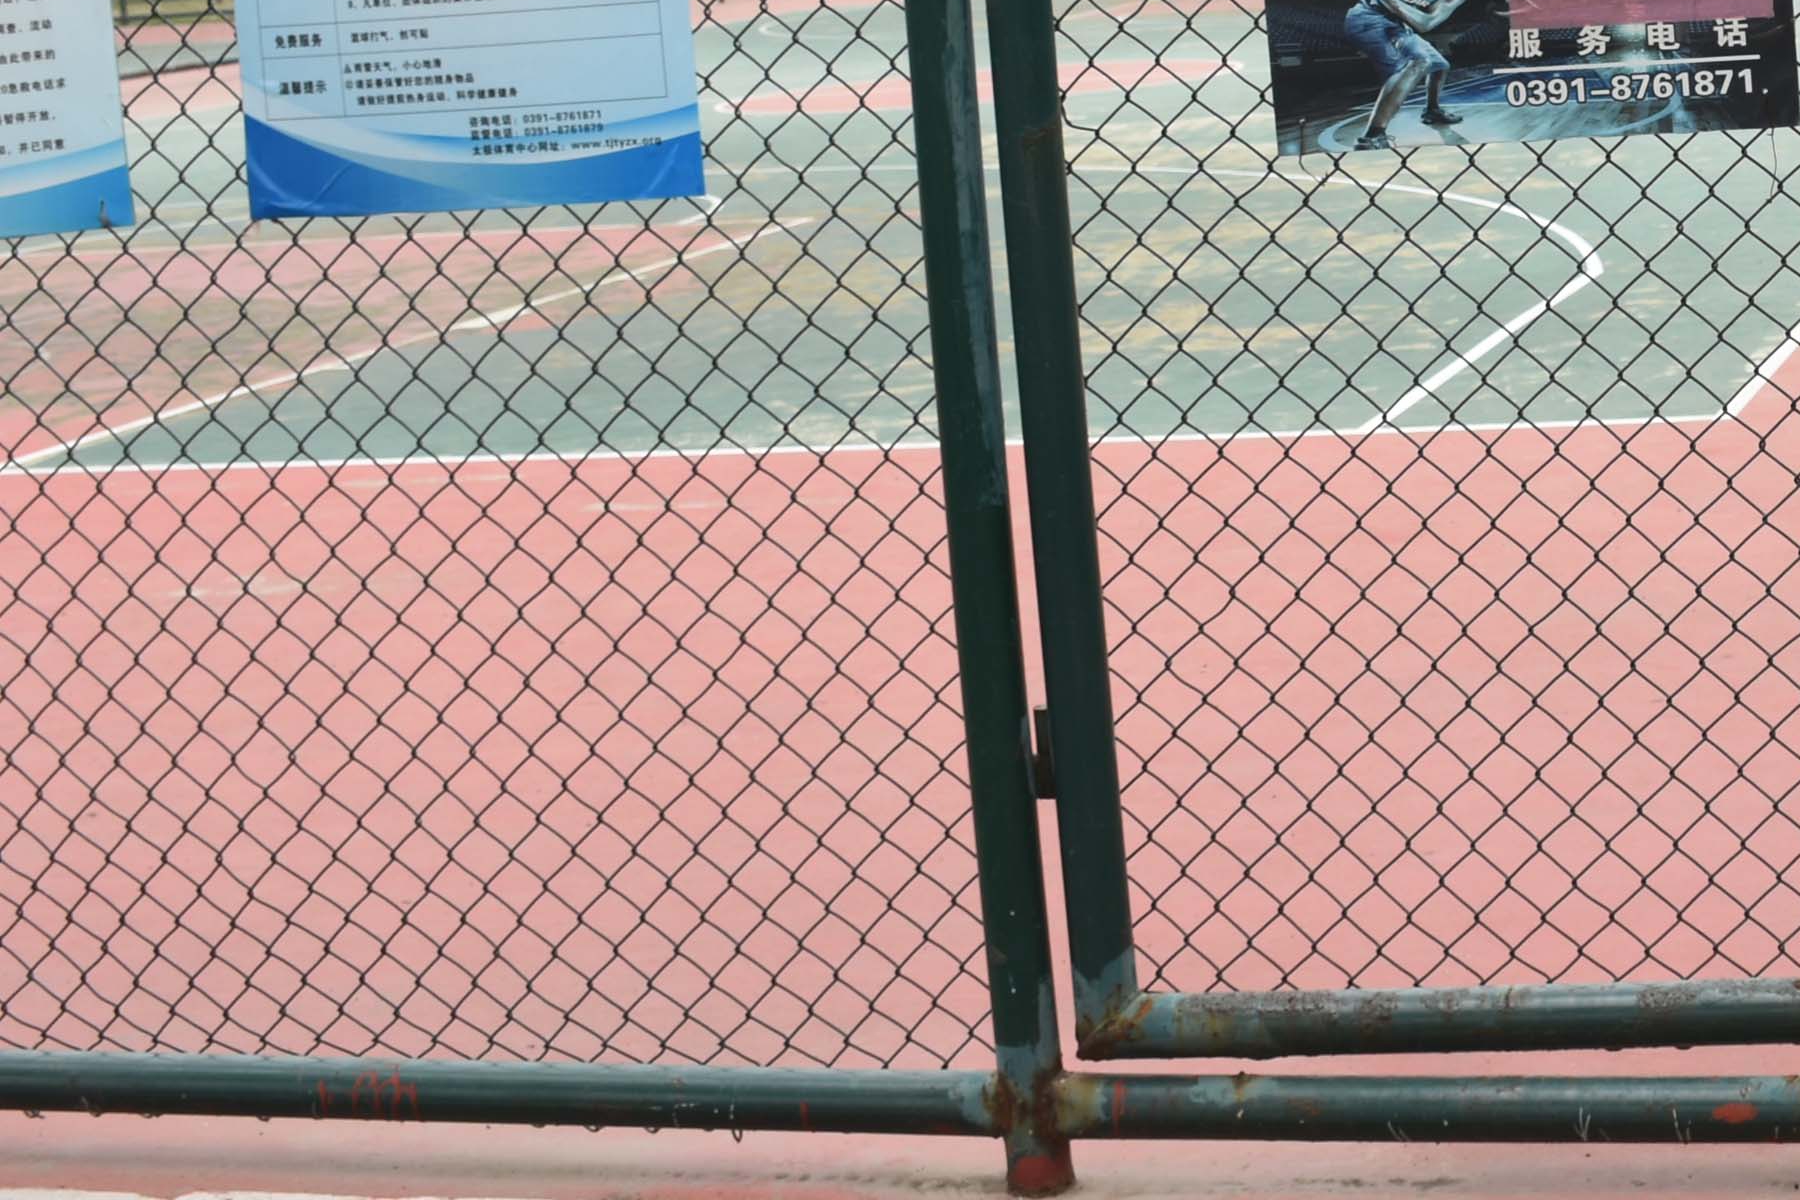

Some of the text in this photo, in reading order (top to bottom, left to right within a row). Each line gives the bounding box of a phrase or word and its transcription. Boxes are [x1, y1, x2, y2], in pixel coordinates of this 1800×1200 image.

[273, 33, 323, 50] 免费服务
[1508, 17, 1748, 59] 服务电话
[277, 79, 327, 96] 温馨提示
